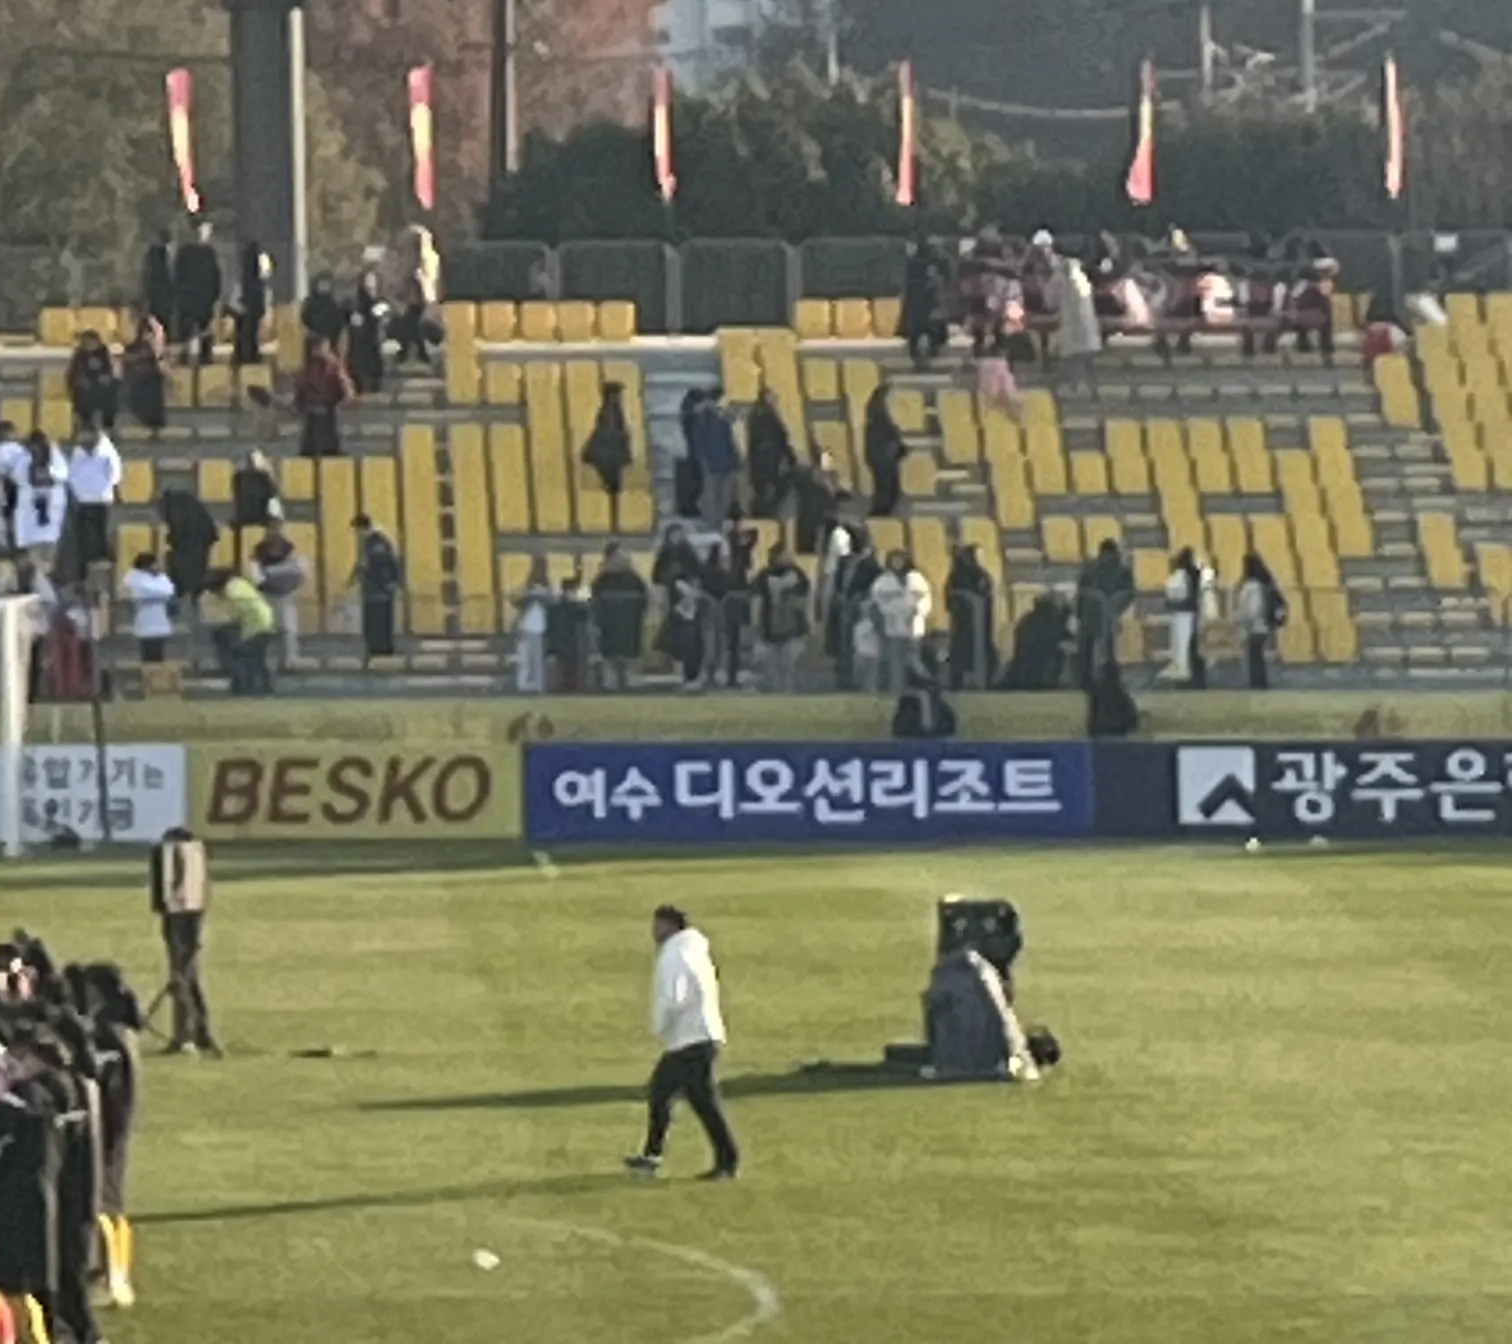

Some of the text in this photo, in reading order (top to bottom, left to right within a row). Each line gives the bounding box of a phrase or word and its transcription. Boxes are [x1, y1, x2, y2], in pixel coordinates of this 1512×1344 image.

[205, 755, 494, 826] BESKO
[551, 766, 663, 821] 여수
[1270, 748, 1512, 823] 광주은
